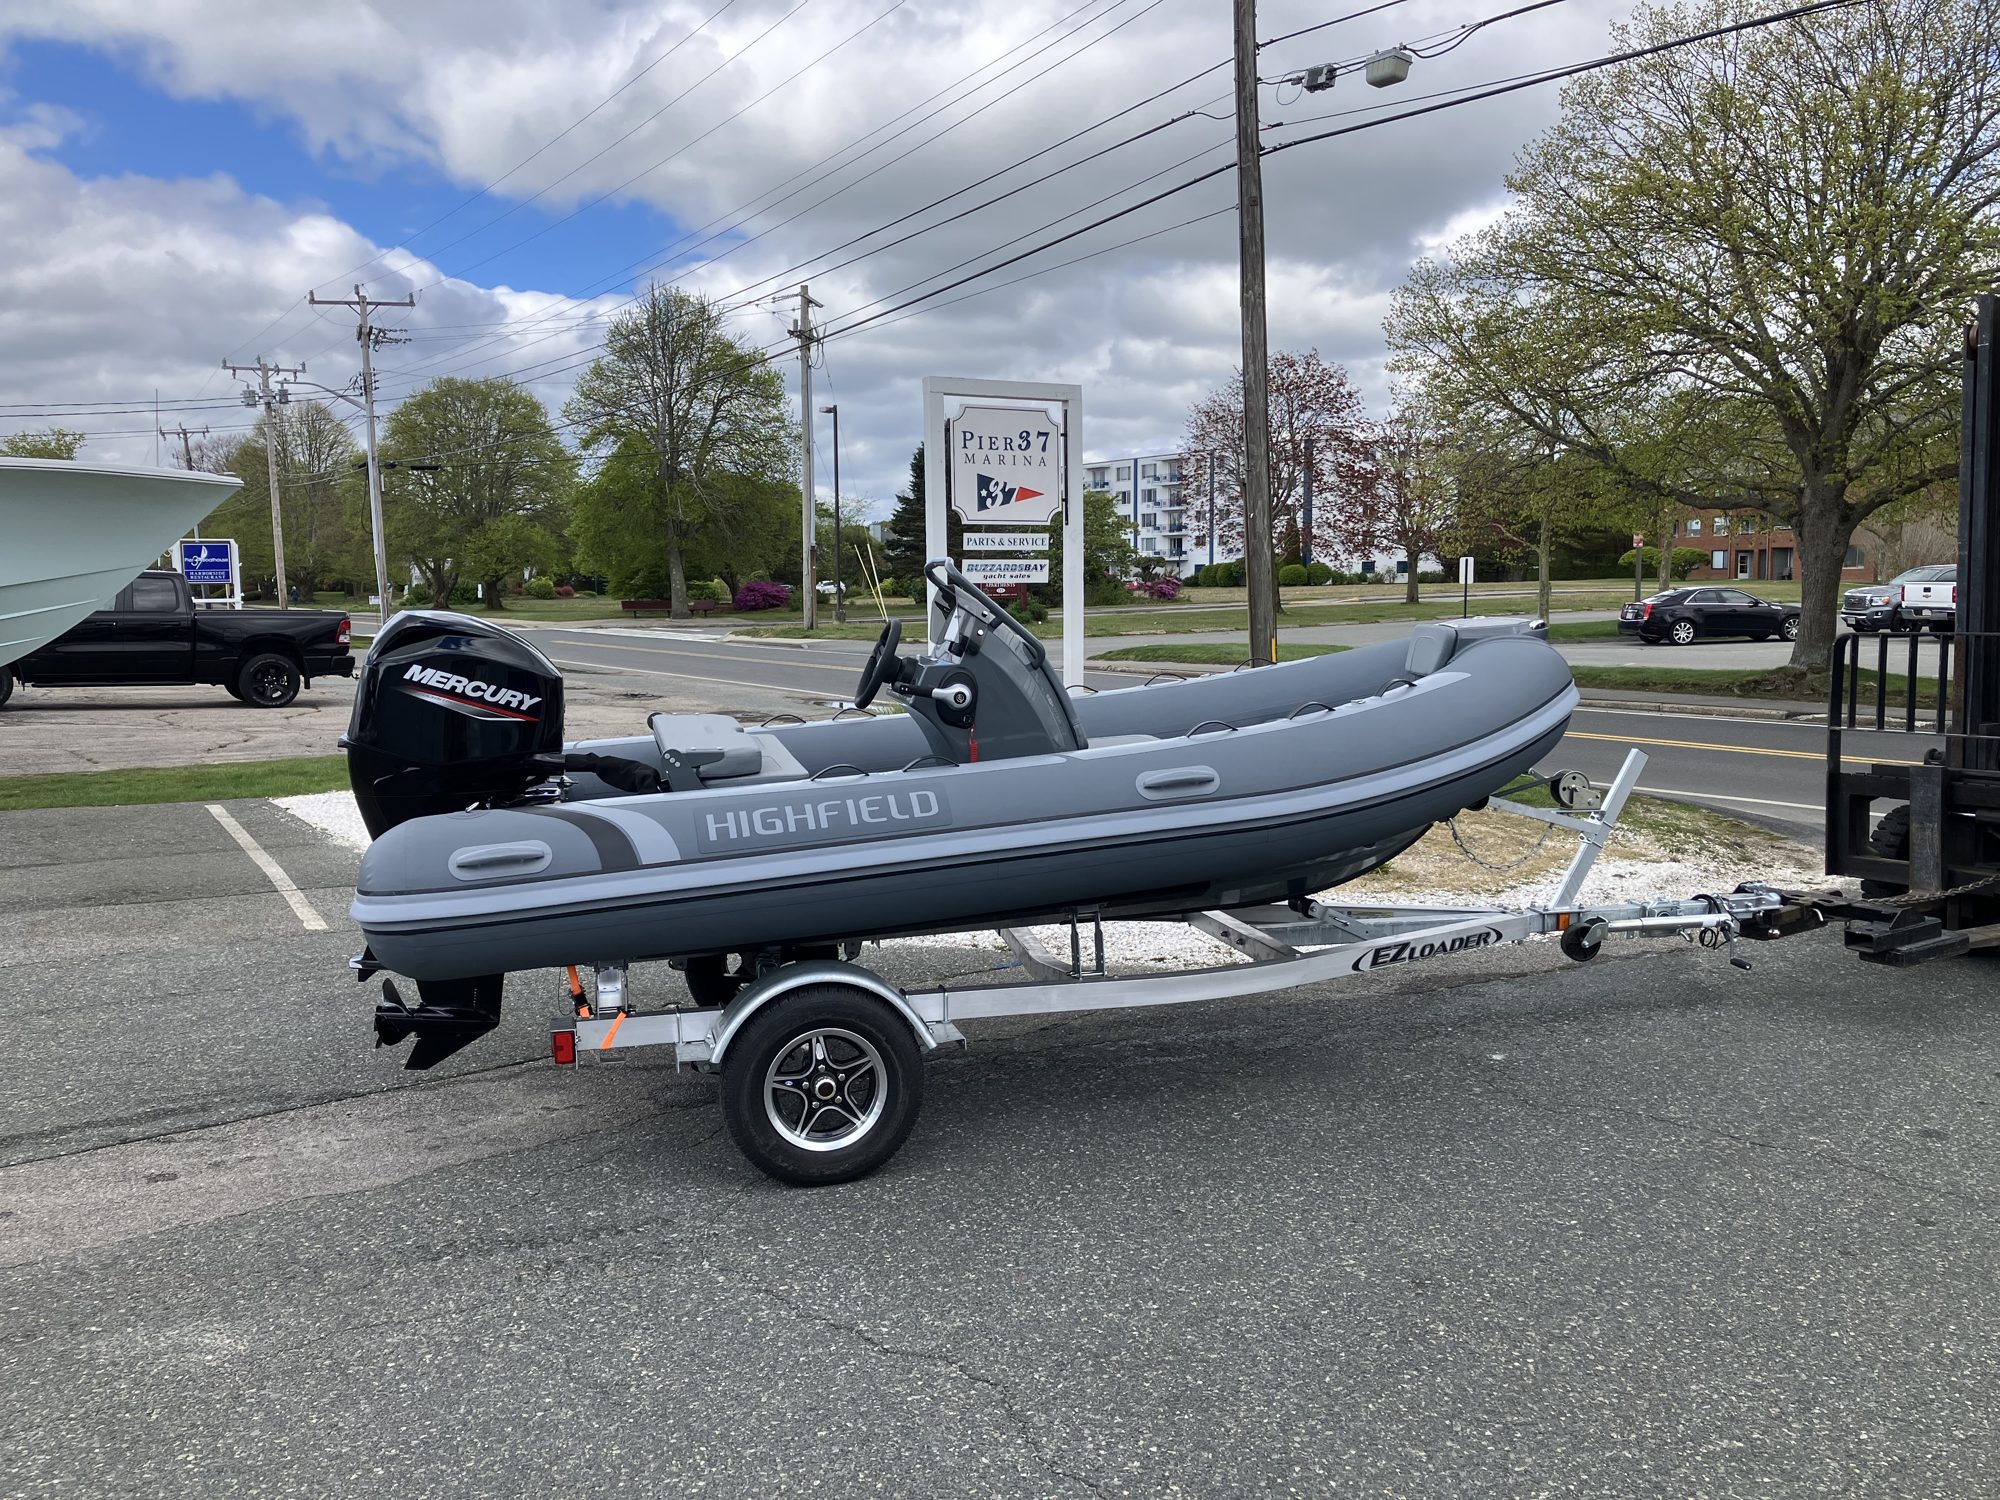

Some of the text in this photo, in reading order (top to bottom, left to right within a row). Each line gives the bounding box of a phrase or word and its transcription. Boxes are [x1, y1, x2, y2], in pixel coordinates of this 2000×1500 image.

[964, 453, 1046, 466] MARINA
[966, 537, 1047, 546] PARTS & SERVICE
[983, 572, 1006, 580] yacht
[403, 664, 542, 710] MERCURY
[706, 790, 940, 841] HIGHFIELD
